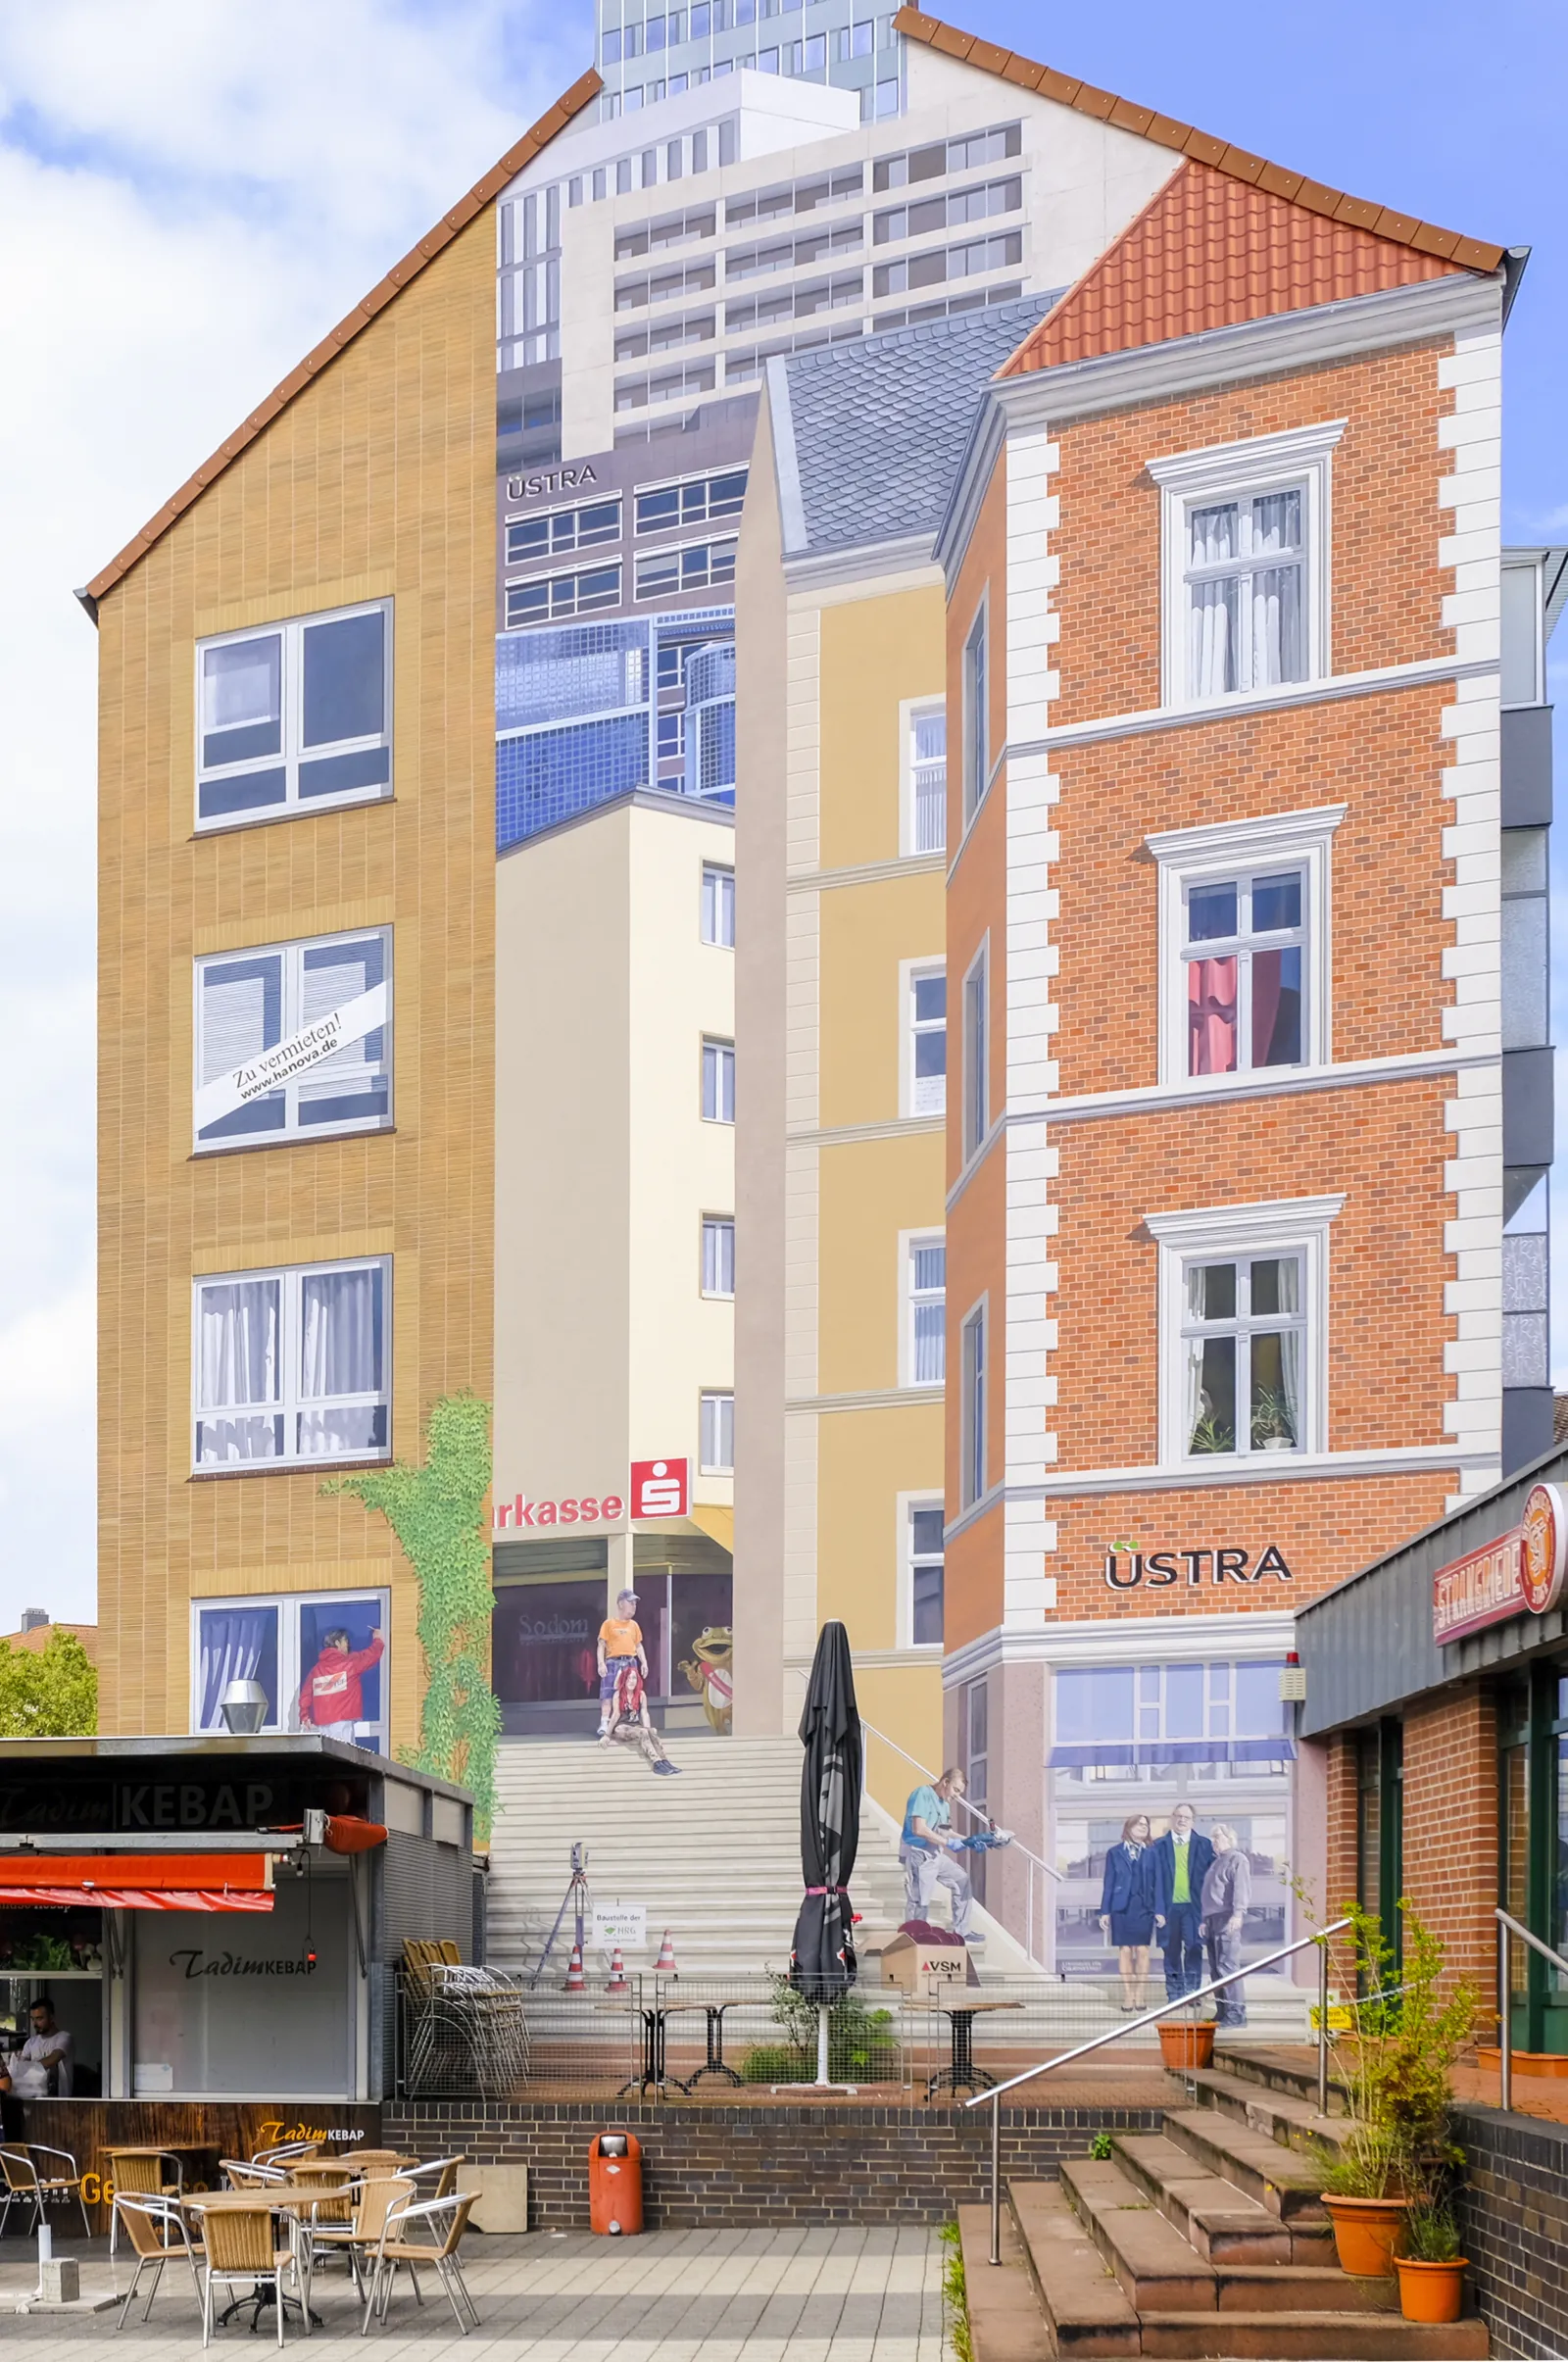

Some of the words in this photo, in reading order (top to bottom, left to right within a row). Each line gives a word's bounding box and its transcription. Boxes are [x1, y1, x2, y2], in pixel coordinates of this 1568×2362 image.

[507, 465, 597, 502] ÜSTRA
[233, 1070, 257, 1089] Zu
[259, 1012, 341, 1072] vermieten!
[241, 1039, 337, 1099] www.hanova.de
[1104, 1541, 1293, 1590] ÜSTRA
[122, 1784, 273, 1827] KEBAP
[929, 1961, 960, 1972] VSM
